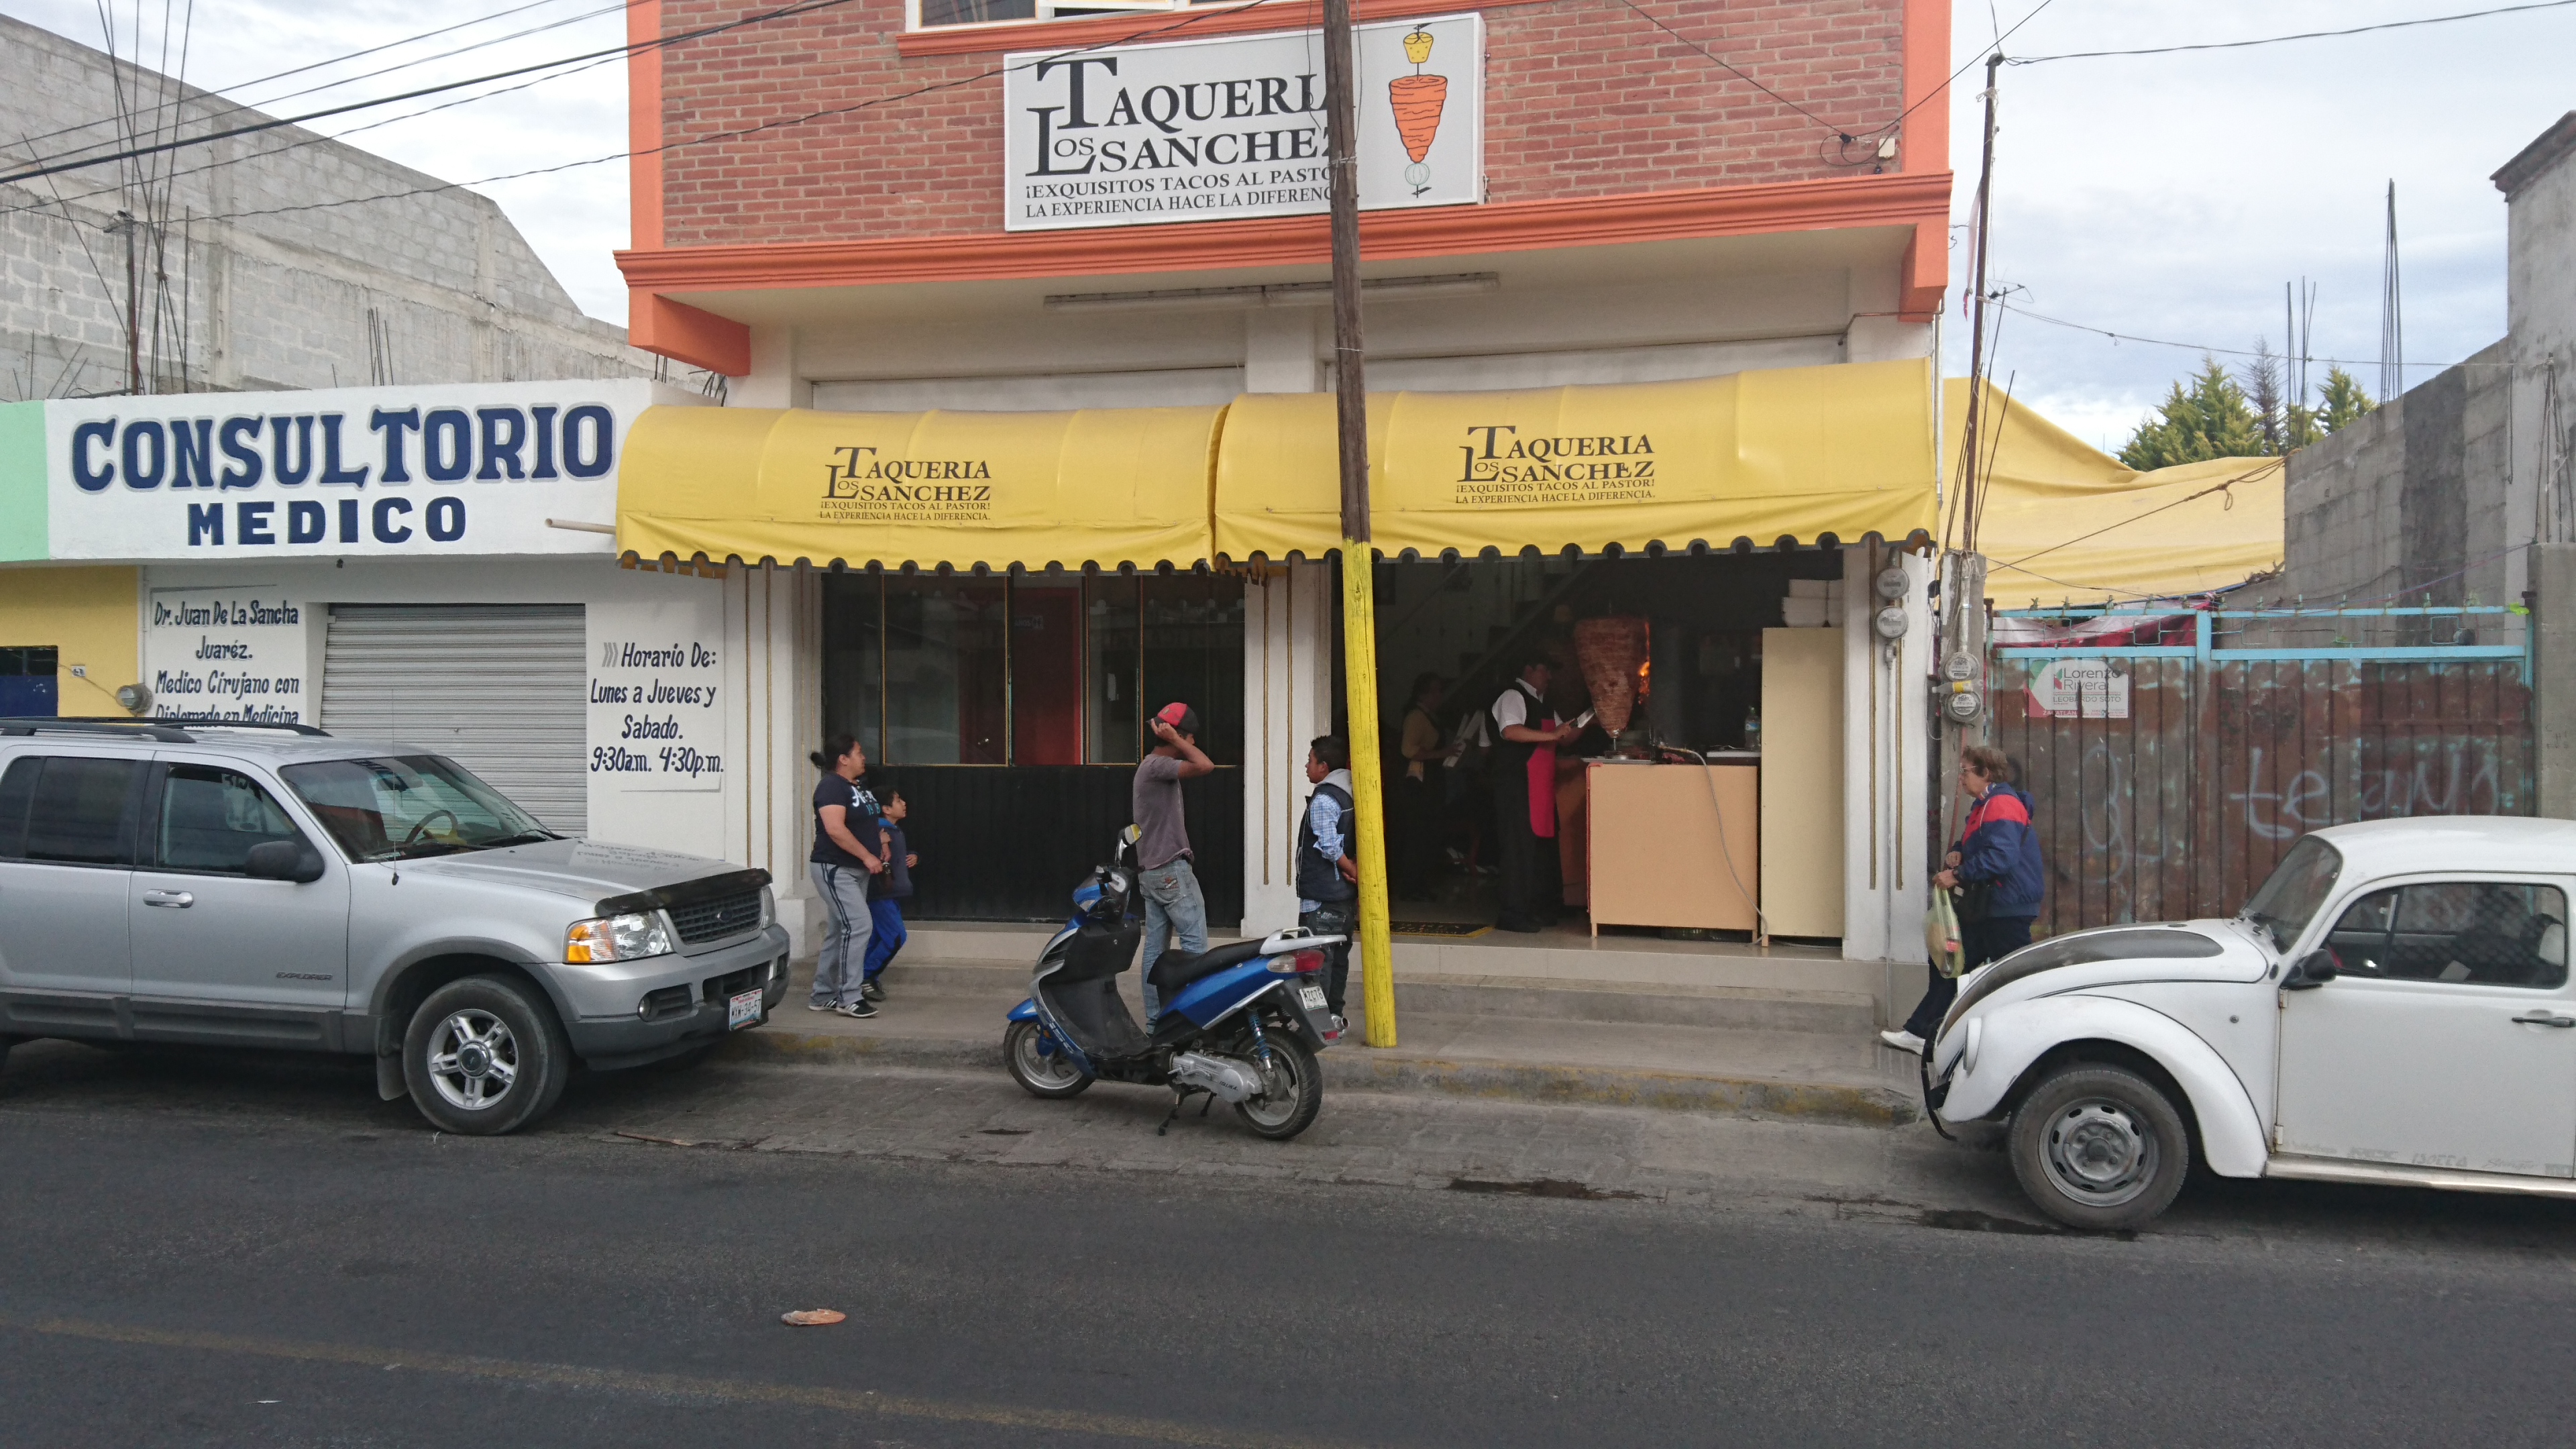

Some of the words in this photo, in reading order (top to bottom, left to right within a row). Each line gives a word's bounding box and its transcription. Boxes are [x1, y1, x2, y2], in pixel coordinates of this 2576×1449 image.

[1037, 57, 1328, 134] TAQUERI
[1161, 173, 1230, 191] TACOS
[1236, 172, 1263, 186] AL
[1026, 203, 1047, 217] LA
[1051, 196, 1164, 217] EXPERIENCIA
[1169, 194, 1216, 210] HACE
[1220, 193, 1242, 207] LA
[71, 402, 613, 492] CONSULTORIO
[1467, 425, 1655, 463] TAQUERIA
[834, 446, 991, 484] TAQUERIA
[1501, 461, 1654, 483] SANCHEZ
[860, 485, 991, 502] SANCHEZ
[1537, 482, 1578, 491] TACOS
[1582, 481, 1599, 490] AL
[1602, 479, 1655, 489] PASTOR!
[946, 502, 990, 511] PASTOR!
[1456, 495, 1468, 504] LA
[1471, 494, 1538, 504] EXPERIENCIA
[1542, 492, 1570, 502] HACE
[1572, 492, 1585, 500] LA
[187, 496, 466, 545] MEDICO
[833, 511, 892, 519] EXPERIENCIA
[894, 513, 918, 521] HACE
[920, 513, 931, 521] LA
[934, 513, 991, 521] DIFERENCIA.
[154, 602, 172, 625] Dr.
[175, 600, 210, 625] Juan
[213, 600, 228, 625] De
[231, 600, 247, 625] La
[249, 600, 299, 625] Sancha
[195, 635, 253, 659] Juaréz.
[621, 642, 684, 667] Horario
[690, 641, 716, 667] De:
[155, 670, 201, 694] Medico
[207, 669, 269, 700] Cirujano
[274, 678, 299, 694] con
[590, 678, 628, 704] Lunes
[633, 686, 643, 703] a
[647, 678, 702, 704] Jueves
[704, 686, 716, 708] y
[621, 714, 684, 739] Sabado.
